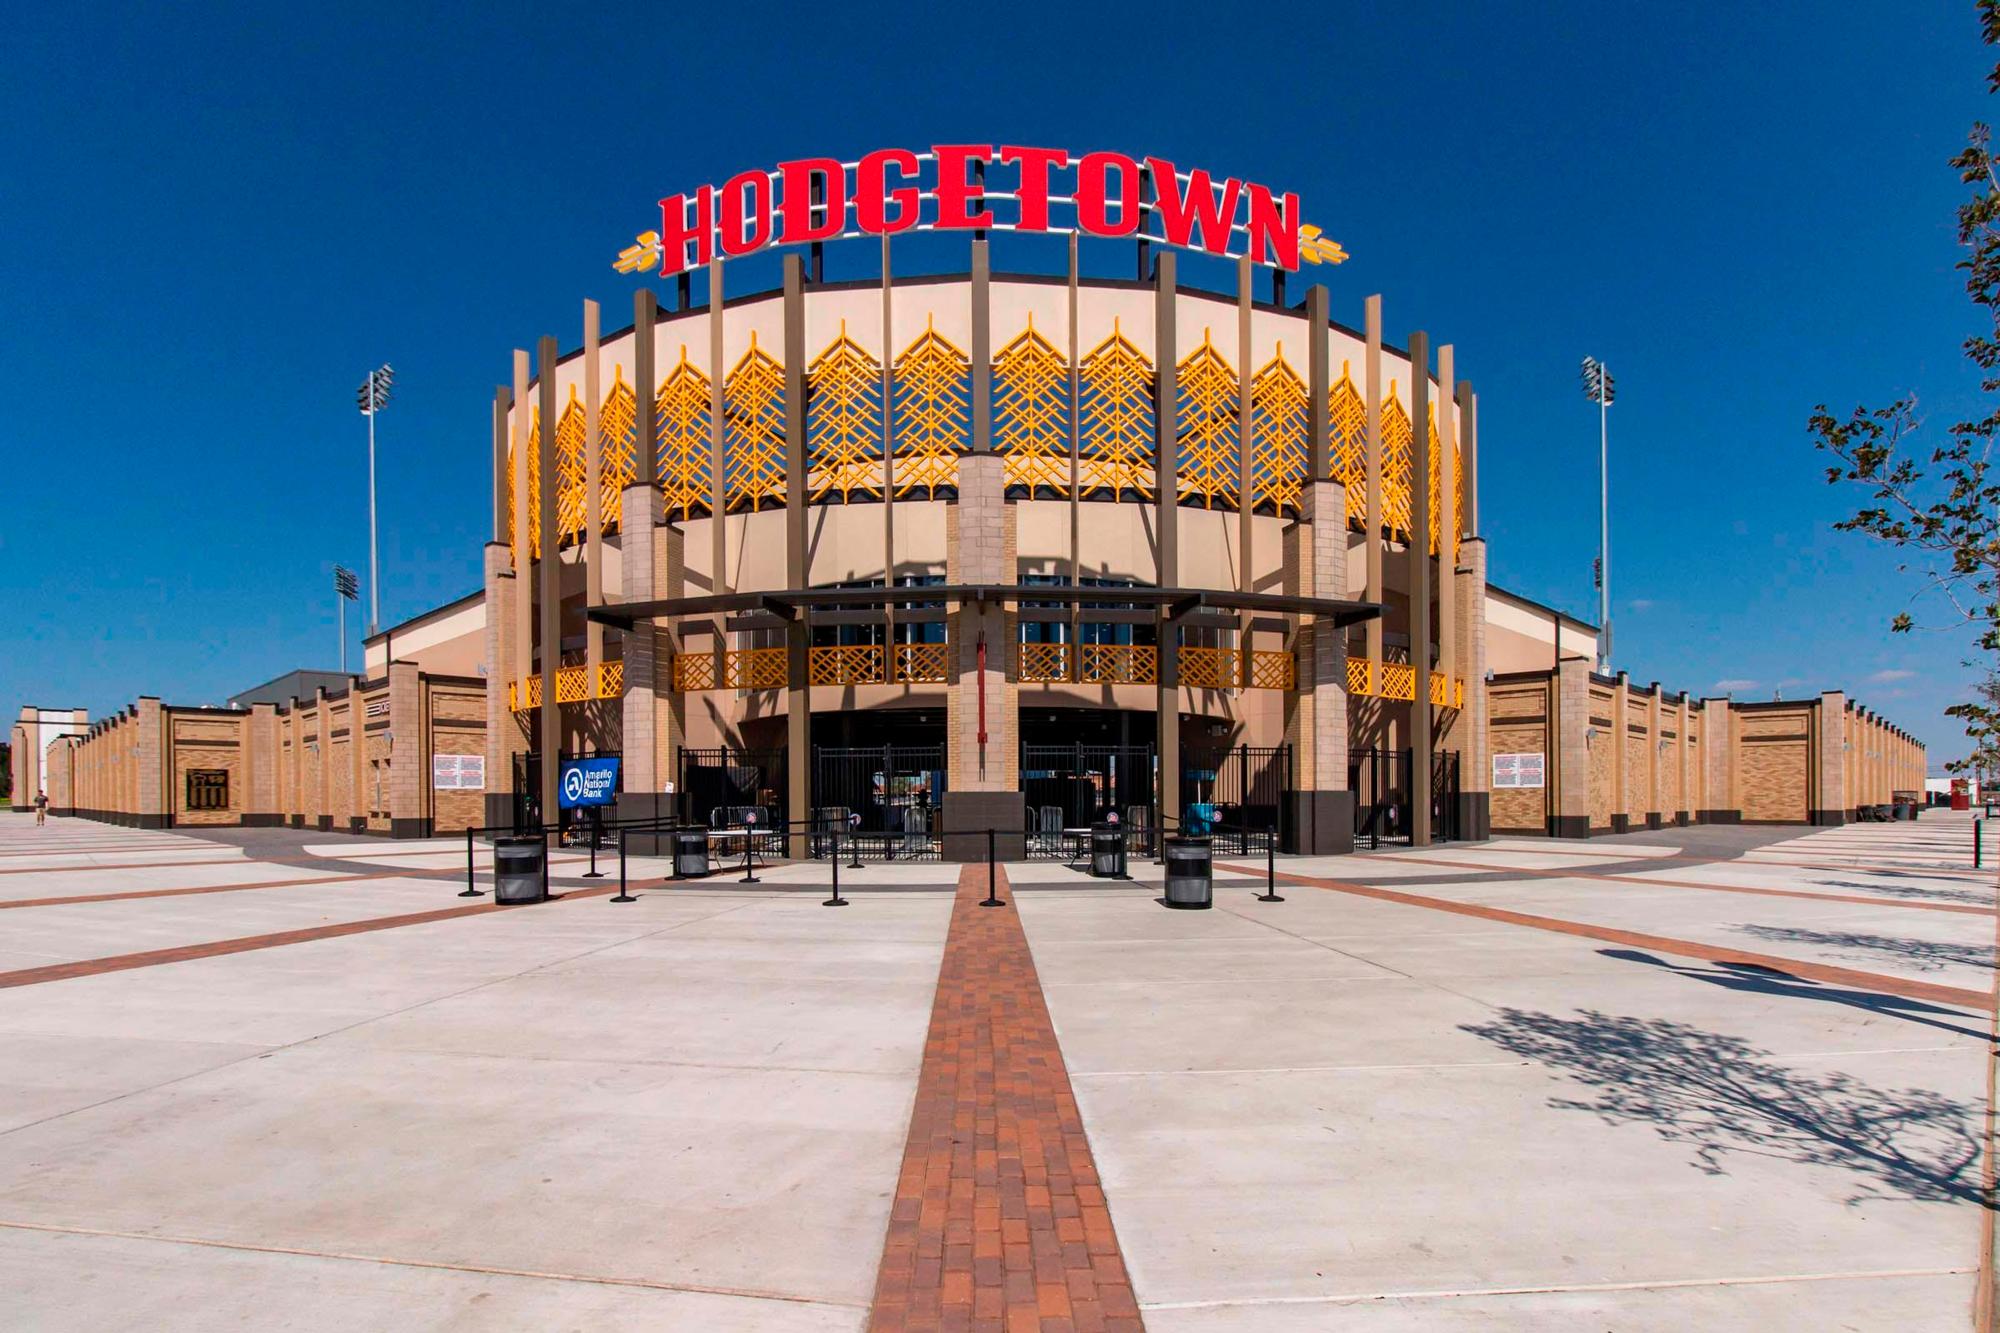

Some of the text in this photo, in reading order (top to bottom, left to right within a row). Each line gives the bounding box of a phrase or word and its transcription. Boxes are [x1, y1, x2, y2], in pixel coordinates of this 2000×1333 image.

[658, 144, 1300, 277] HODGETOWN
[585, 769, 613, 779] Amarillo
[584, 779, 611, 788] National
[583, 788, 602, 798] Bank
